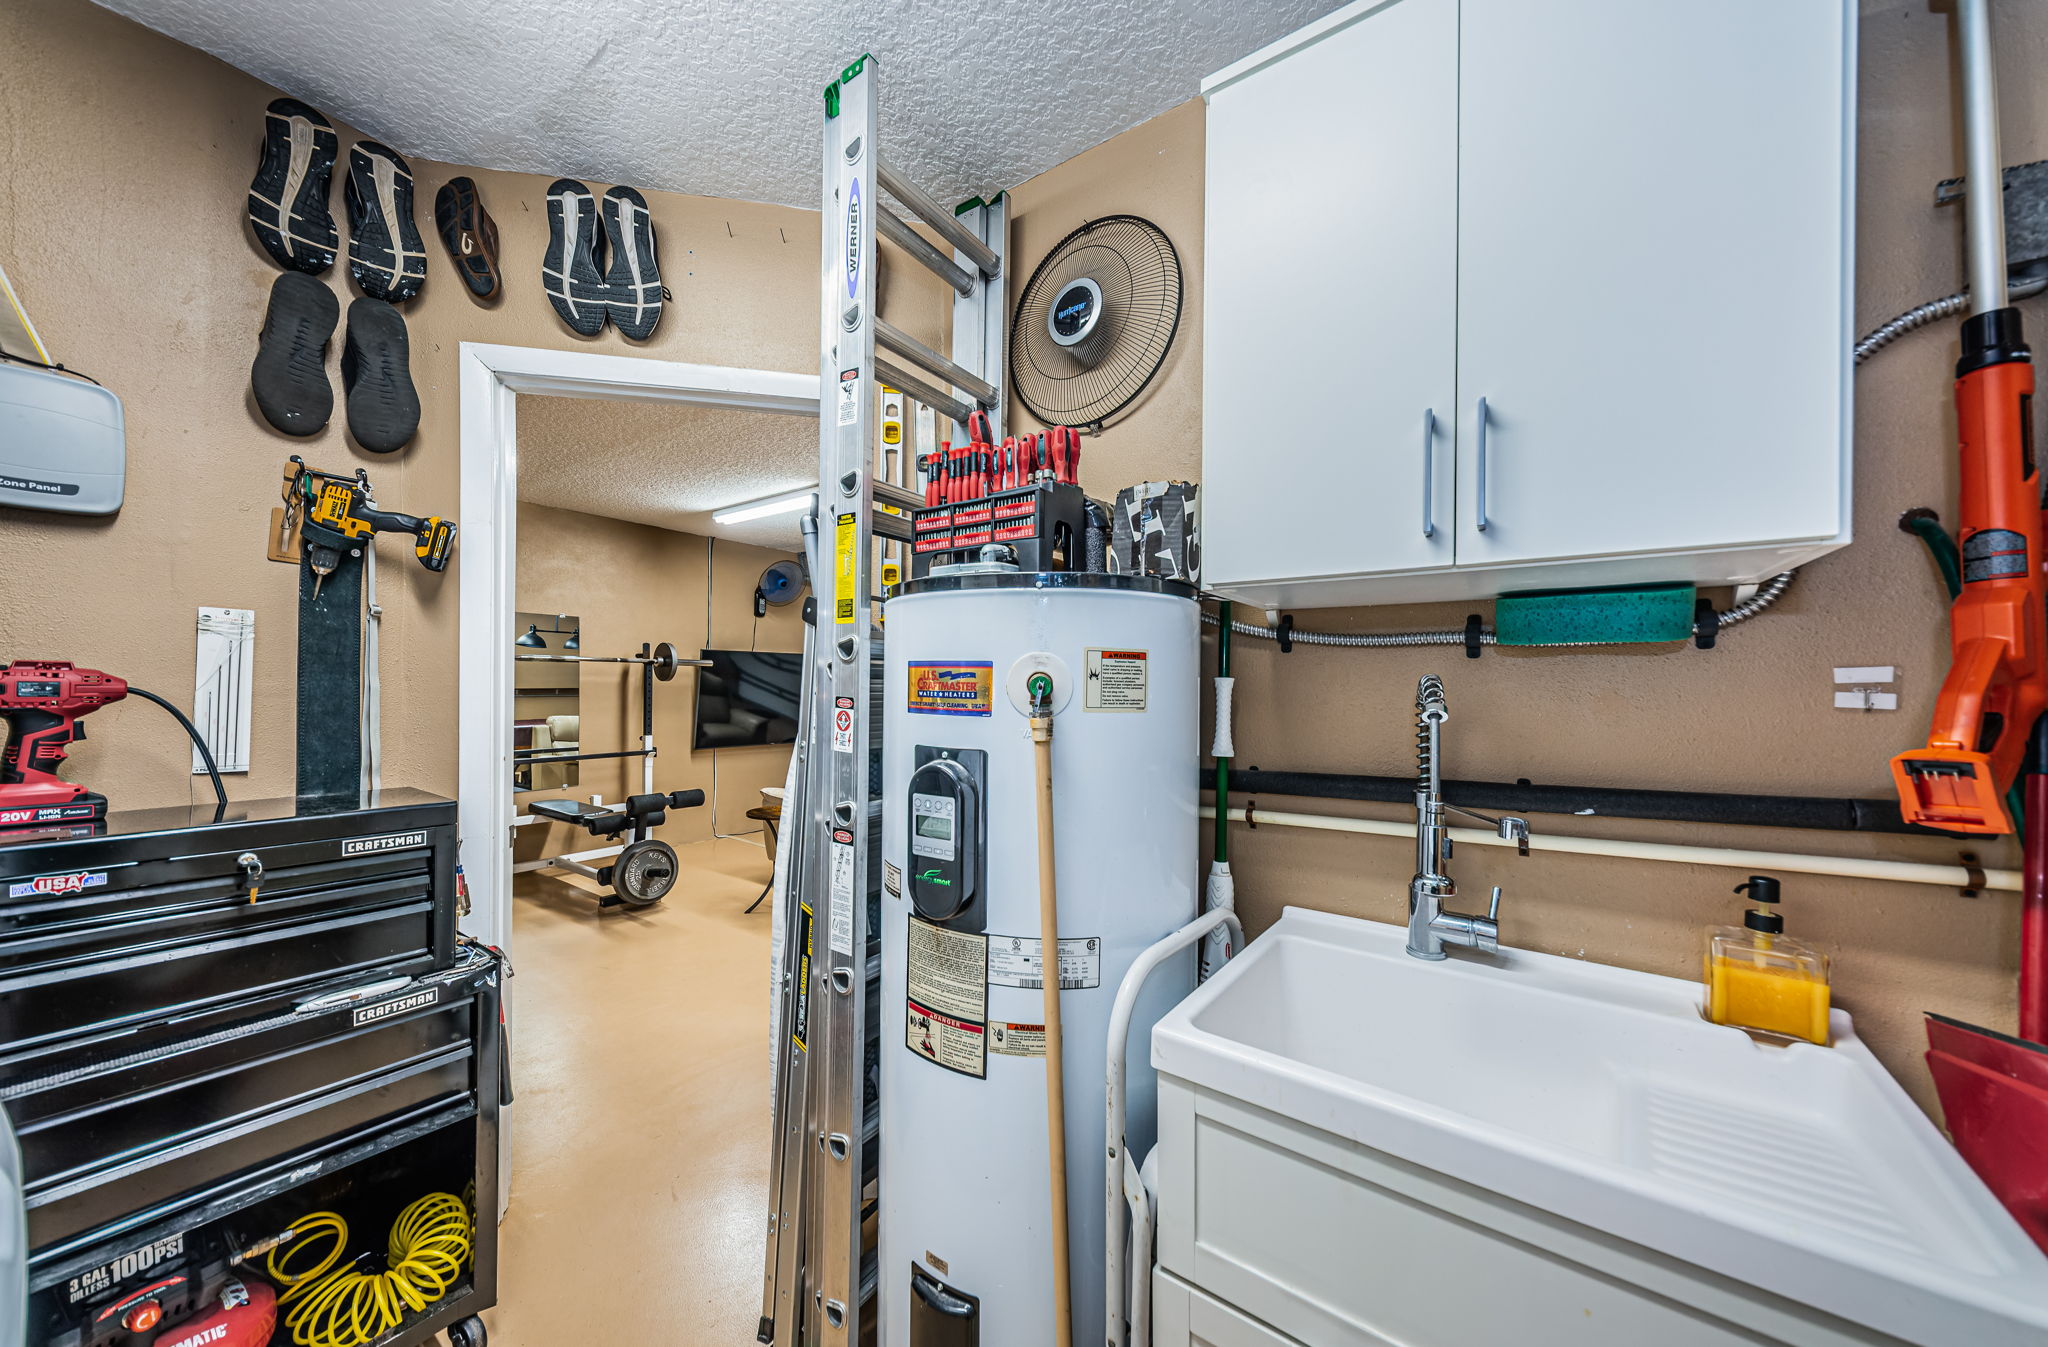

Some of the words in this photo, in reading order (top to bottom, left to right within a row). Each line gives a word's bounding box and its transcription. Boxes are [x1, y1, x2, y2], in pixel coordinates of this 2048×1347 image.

[849, 202, 858, 273] WERNER
[0, 478, 26, 488] Zone
[29, 482, 61, 493] Panel
[923, 670, 939, 681] U.S.
[917, 677, 977, 691] CRAFTMASTER
[0, 812, 31, 822] 20V
[347, 834, 422, 853] CRAFTSMAN
[648, 852, 667, 863] KEYS
[38, 875, 78, 891] USA
[358, 992, 434, 1022] CRAFTSMAN
[934, 1014, 961, 1028] DANGER
[1019, 1024, 1045, 1032] WARNI
[110, 1244, 154, 1284] 100
[154, 1238, 184, 1265] PSI
[69, 1277, 79, 1294] 3
[82, 1266, 109, 1290] GAL
[70, 1278, 110, 1304] OILLESS
[171, 1324, 228, 1347] MATIC
